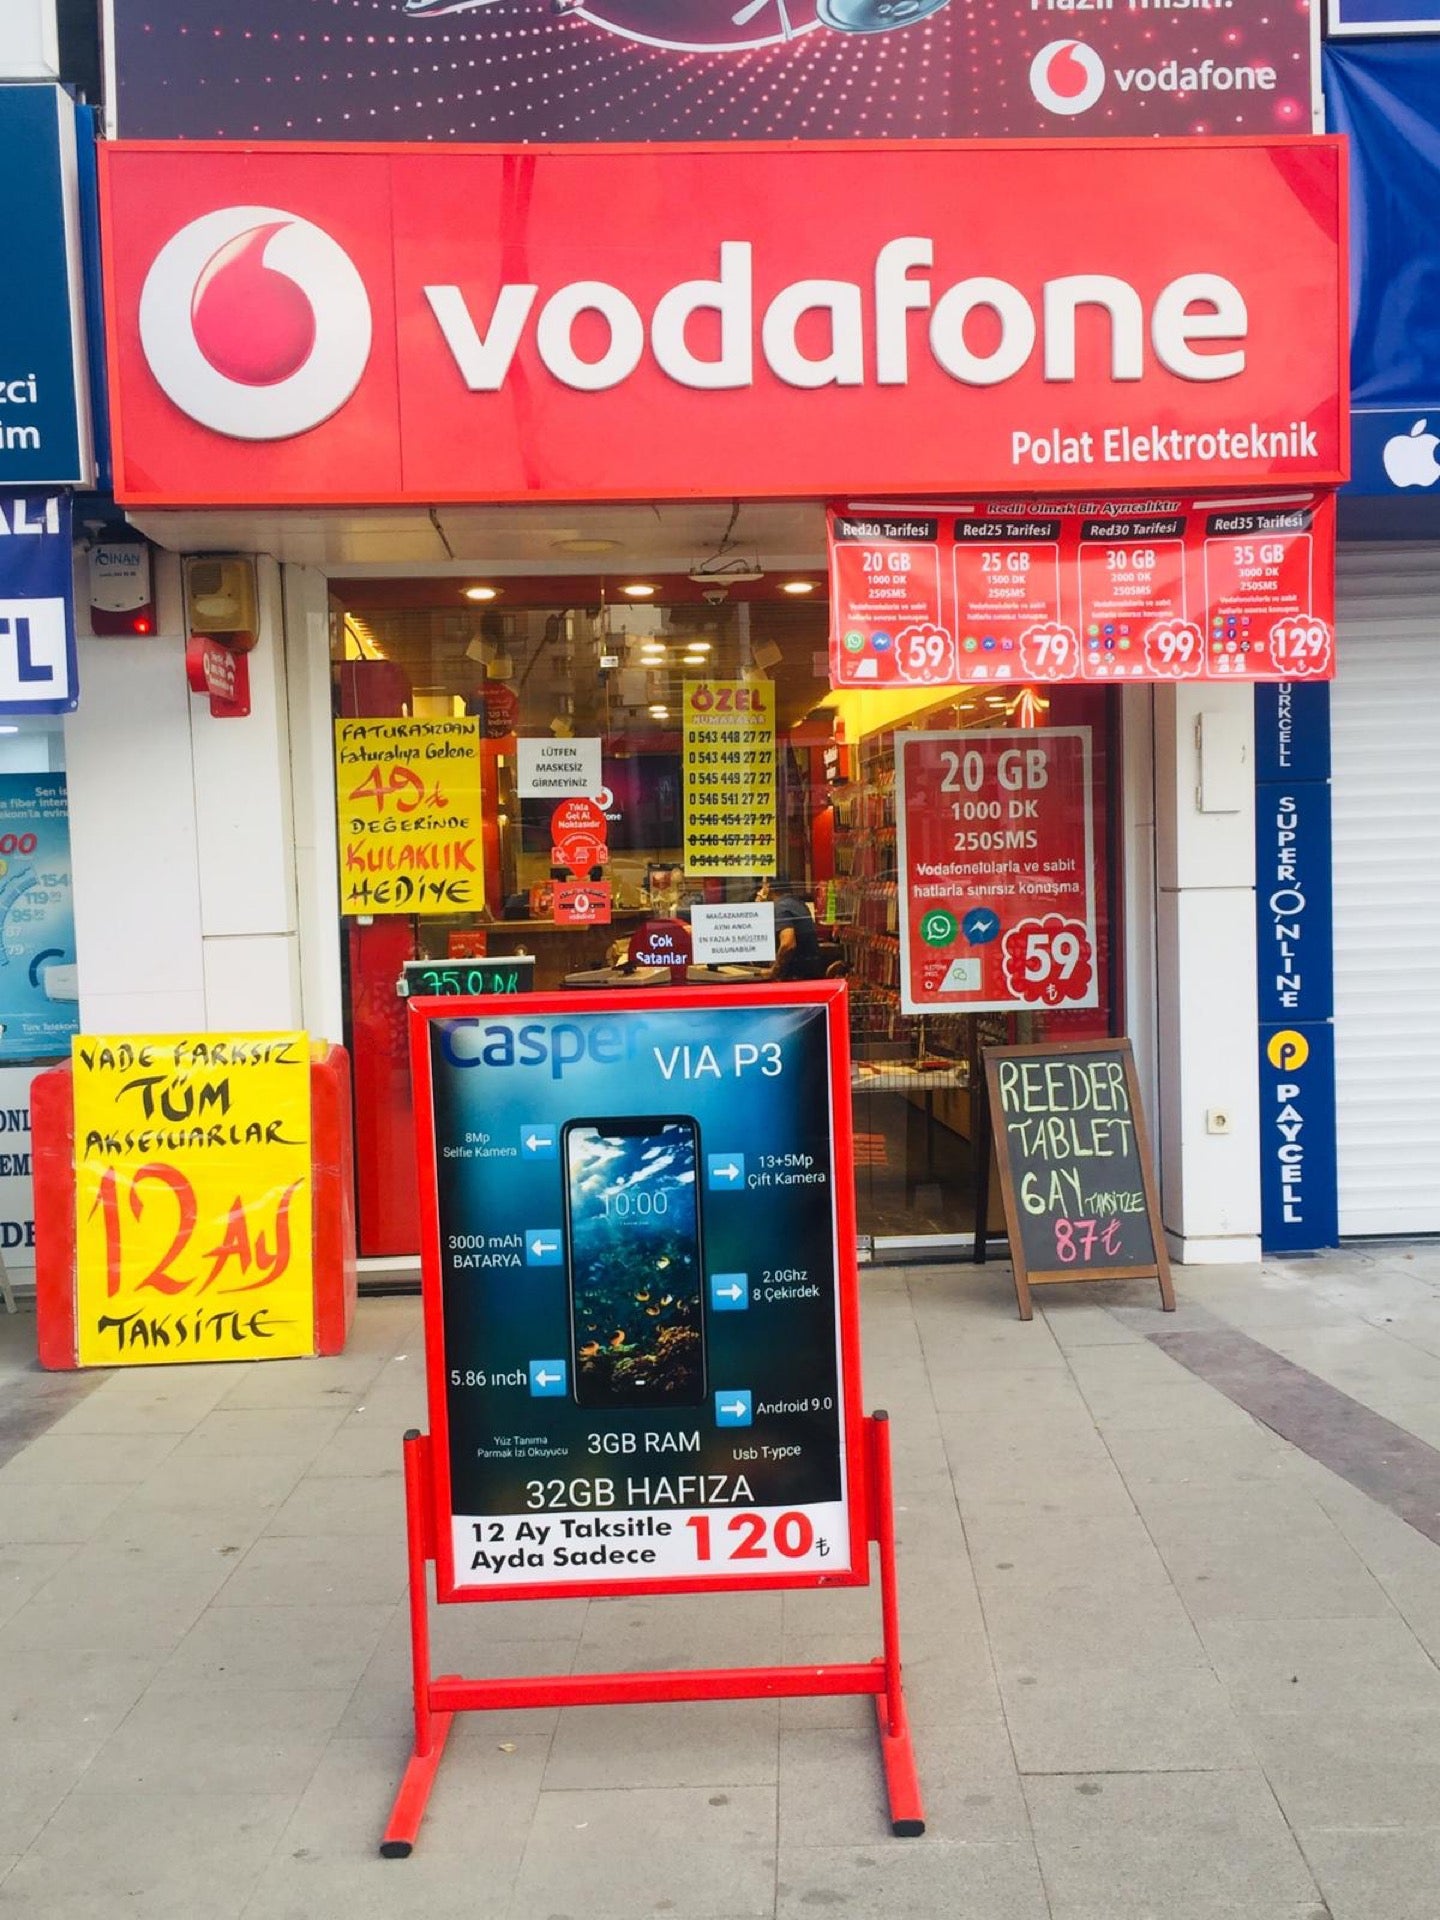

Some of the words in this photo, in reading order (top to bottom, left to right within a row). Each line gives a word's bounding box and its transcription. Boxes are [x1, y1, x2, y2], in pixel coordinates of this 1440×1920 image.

[1114, 60, 1277, 91] vodafone
[423, 236, 1248, 393] vodafone
[1011, 430, 1093, 464] Polat
[1103, 422, 1318, 462] Elektroteknik
[1030, 503, 1076, 514] Olmak
[1078, 502, 1100, 514] Bir
[1102, 501, 1180, 517] Ayrıcalıktır
[842, 523, 881, 536] Red20
[884, 523, 929, 536] Tarifesi
[963, 524, 1003, 536] Red25
[1006, 524, 1051, 536] Tarifesi
[1090, 524, 1130, 536] Red30
[1133, 521, 1177, 535] Tarifesi
[1214, 517, 1254, 530] Red35
[1257, 514, 1304, 529] Tarifesi
[863, 552, 883, 572] 20
[887, 552, 912, 572] GB
[981, 552, 1002, 572] 25
[1007, 552, 1031, 572] GB
[1106, 550, 1127, 570] 30
[1132, 549, 1156, 569] GB
[1233, 545, 1255, 565] 35
[1259, 544, 1285, 564] GB
[892, 575, 907, 585] DK
[1012, 575, 1026, 585] DK
[1137, 572, 1152, 582] DK
[1265, 567, 1280, 577] DK
[868, 589, 907, 599] 250SMS
[988, 588, 1026, 599] 250SMS
[1113, 586, 1152, 596] 250SMS
[1240, 581, 1278, 591] 250SMS
[909, 635, 945, 668] 59
[1033, 634, 1069, 666] 79
[1157, 630, 1195, 664] 99
[1275, 627, 1324, 658] 129
[691, 683, 767, 712] ÖZEL
[342, 723, 475, 741] FATURASIZDAN
[689, 731, 696, 743] 0
[698, 731, 718, 743] 543
[720, 731, 740, 743] 448
[743, 731, 756, 743] 27
[758, 731, 771, 743] 27
[341, 744, 420, 764] Faturalıya
[425, 741, 475, 760] Gelene
[541, 746, 577, 756] LÜTFEN
[689, 752, 696, 764] 0
[698, 752, 718, 764] 543
[720, 752, 740, 764] 449
[743, 752, 756, 764] 27
[758, 752, 771, 764] 27
[536, 762, 583, 772] MASKESİZ
[940, 750, 984, 793] 20
[997, 749, 1049, 792] GB
[532, 777, 588, 787] GİRMEYİNİZ
[951, 802, 1001, 820] 1000
[1008, 800, 1039, 818] DK
[352, 815, 470, 834] DEĞERİNDE
[954, 830, 1038, 851] 250SMS
[346, 838, 476, 873] KULAKLIK
[1024, 861, 1039, 873] ve
[1043, 858, 1076, 872] sabit
[347, 875, 474, 907] HEDİYE
[914, 884, 963, 898] hatlarla
[967, 885, 1015, 897] sınırsız
[1018, 881, 1080, 896] konuşma
[650, 934, 673, 949] Çok
[636, 951, 689, 965] Satanlar
[1024, 932, 1080, 983] 59
[423, 971, 483, 996] 750
[494, 972, 518, 994] DK
[80, 1043, 154, 1072] VADE
[173, 1040, 303, 1067] FARKSIZ
[441, 1018, 650, 1079] Casper
[653, 1044, 721, 1080] VIA
[734, 1042, 783, 1077] P3
[1000, 1062, 1128, 1112] REEDER
[115, 1075, 234, 1121] TÜM
[84, 1120, 307, 1161] AKSESUARLAR
[465, 1133, 490, 1144] 8Mp
[1008, 1117, 1131, 1160] TABLET
[443, 1147, 473, 1158] Selfie
[475, 1146, 518, 1157] Kamera
[1275, 1084, 1304, 1223] PAYCELL
[759, 1154, 814, 1169] 13+5Mp
[747, 1174, 771, 1189] Çift
[775, 1172, 826, 1185] Kamera
[601, 1191, 669, 1217] 10:00
[88, 1163, 200, 1297] 12
[449, 1235, 485, 1249] 3000
[489, 1234, 523, 1248] mAh
[453, 1254, 522, 1268] BATARYA
[762, 1269, 808, 1284] 2.0Ghz
[753, 1288, 761, 1301] 8
[765, 1285, 820, 1303] Çekirdek
[97, 1308, 299, 1351] TAKSİTLE
[451, 1370, 486, 1386] 5.86
[756, 1399, 808, 1415] Android
[811, 1397, 833, 1411] 9.0
[493, 1435, 511, 1446] Yüz
[514, 1435, 548, 1445] Tanıma
[587, 1433, 636, 1454] 3GB
[645, 1430, 701, 1452] RAM
[477, 1448, 512, 1458] Parmak
[514, 1447, 526, 1457] İzi
[527, 1447, 569, 1458] Okuyucu
[732, 1447, 758, 1460] Usb
[761, 1445, 802, 1461] T-ypce
[526, 1477, 615, 1509] 32GB
[627, 1474, 755, 1506] HAFIZA
[472, 1522, 505, 1542] 12
[515, 1521, 551, 1546] Ay
[560, 1517, 672, 1539] Taksitle
[470, 1547, 545, 1574] Ayda
[553, 1543, 656, 1567] Sadece
